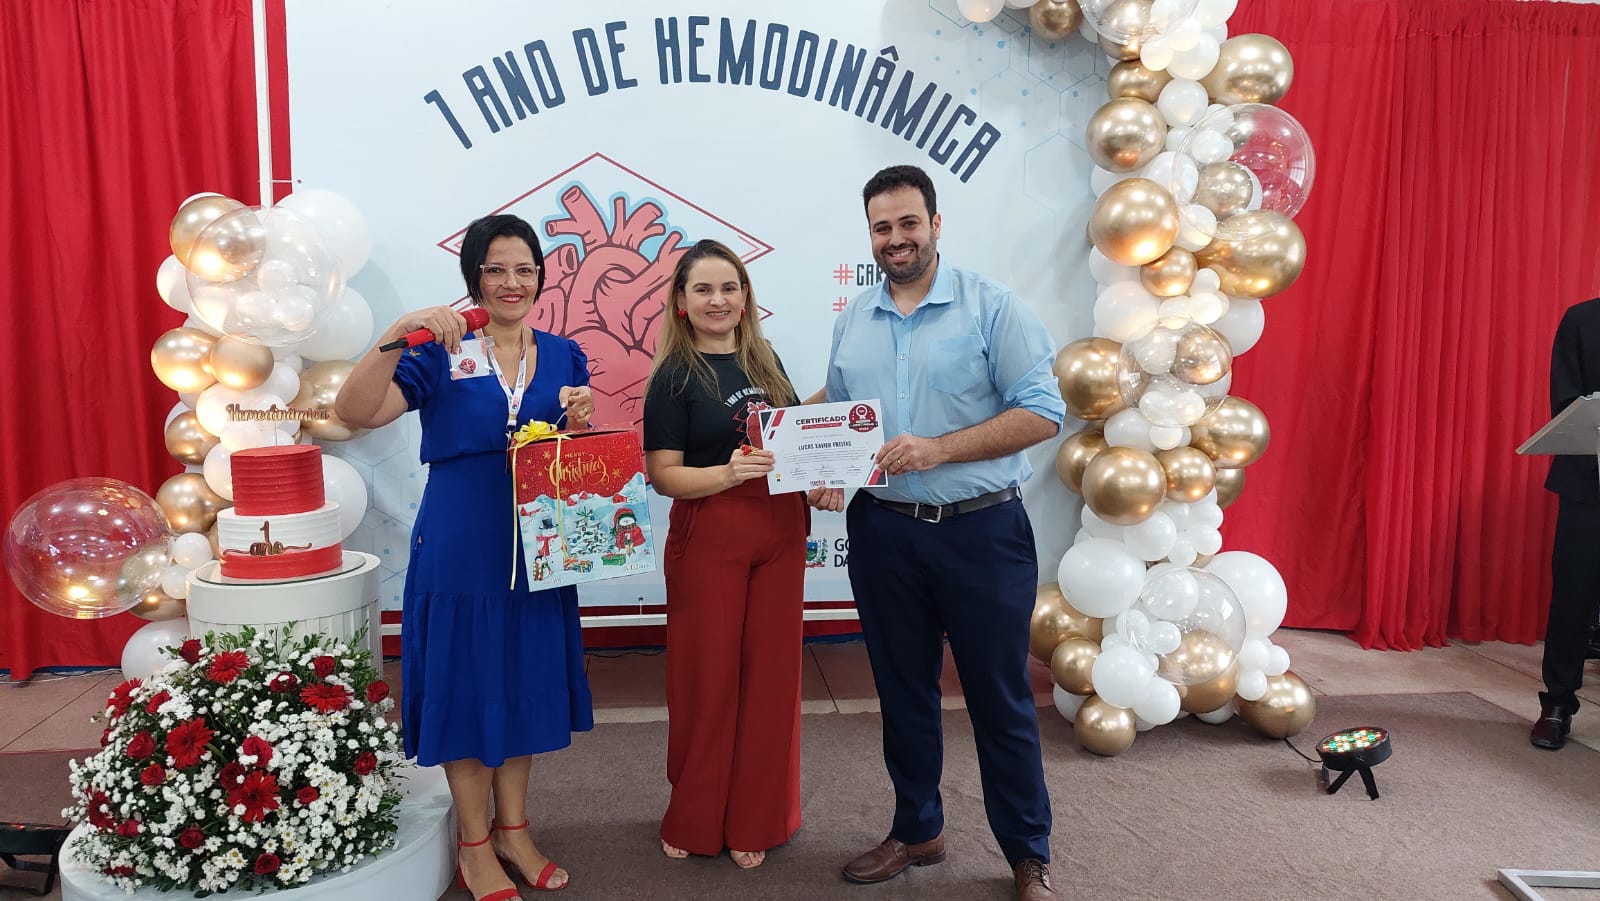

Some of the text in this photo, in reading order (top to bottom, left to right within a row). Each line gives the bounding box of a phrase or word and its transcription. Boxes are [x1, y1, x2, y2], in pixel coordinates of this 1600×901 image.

[424, 16, 1001, 183] 1 ANO DE HEMODINÂMICA
[795, 415, 847, 425] CERTIFICADO
[798, 443, 814, 451] LUCAS
[564, 451, 586, 459] MERRY
[259, 520, 270, 544] 1
